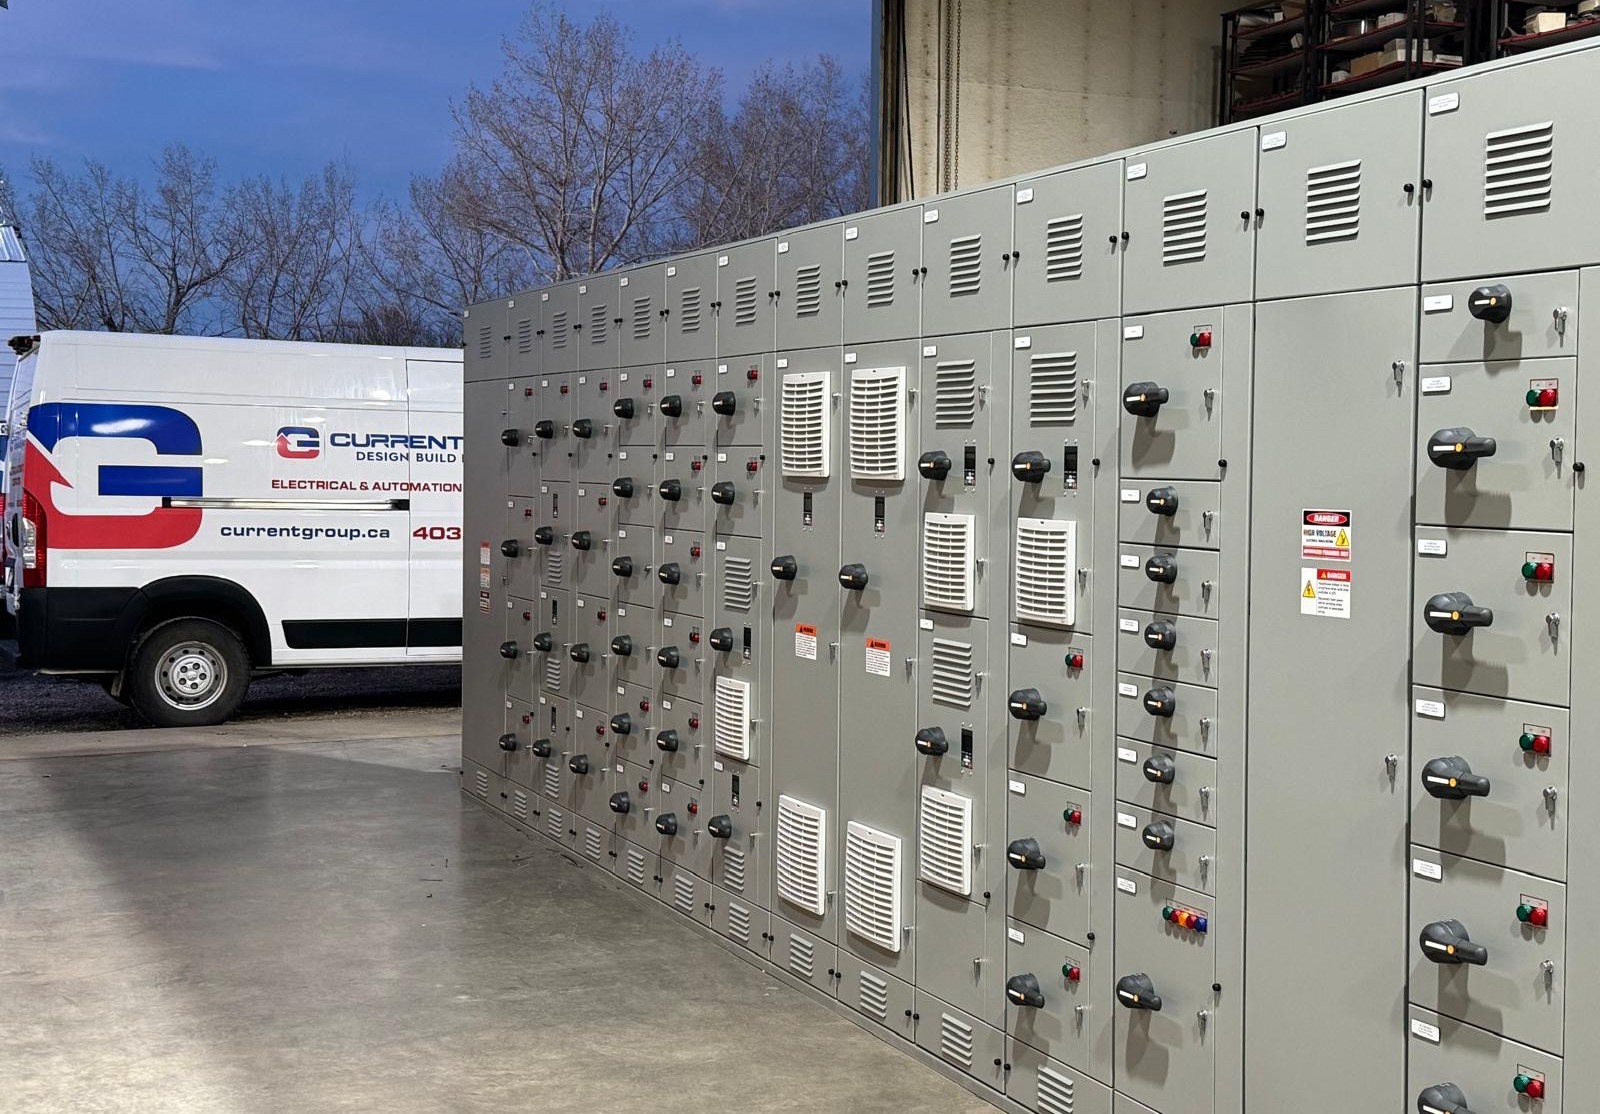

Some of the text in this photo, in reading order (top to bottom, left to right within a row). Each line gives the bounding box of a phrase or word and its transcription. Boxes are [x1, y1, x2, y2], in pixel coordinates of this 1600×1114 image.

[330, 432, 464, 450] CURRENT
[356, 451, 409, 462] DESIGN
[416, 453, 457, 463] BUILD
[271, 479, 462, 493] ELECTRICAL & AUTOMATION
[1314, 514, 1339, 523] DANGER
[220, 525, 462, 541] currentgroup.ca 403
[1316, 529, 1336, 537] VOLTAGE
[1327, 572, 1347, 580] DANGER
